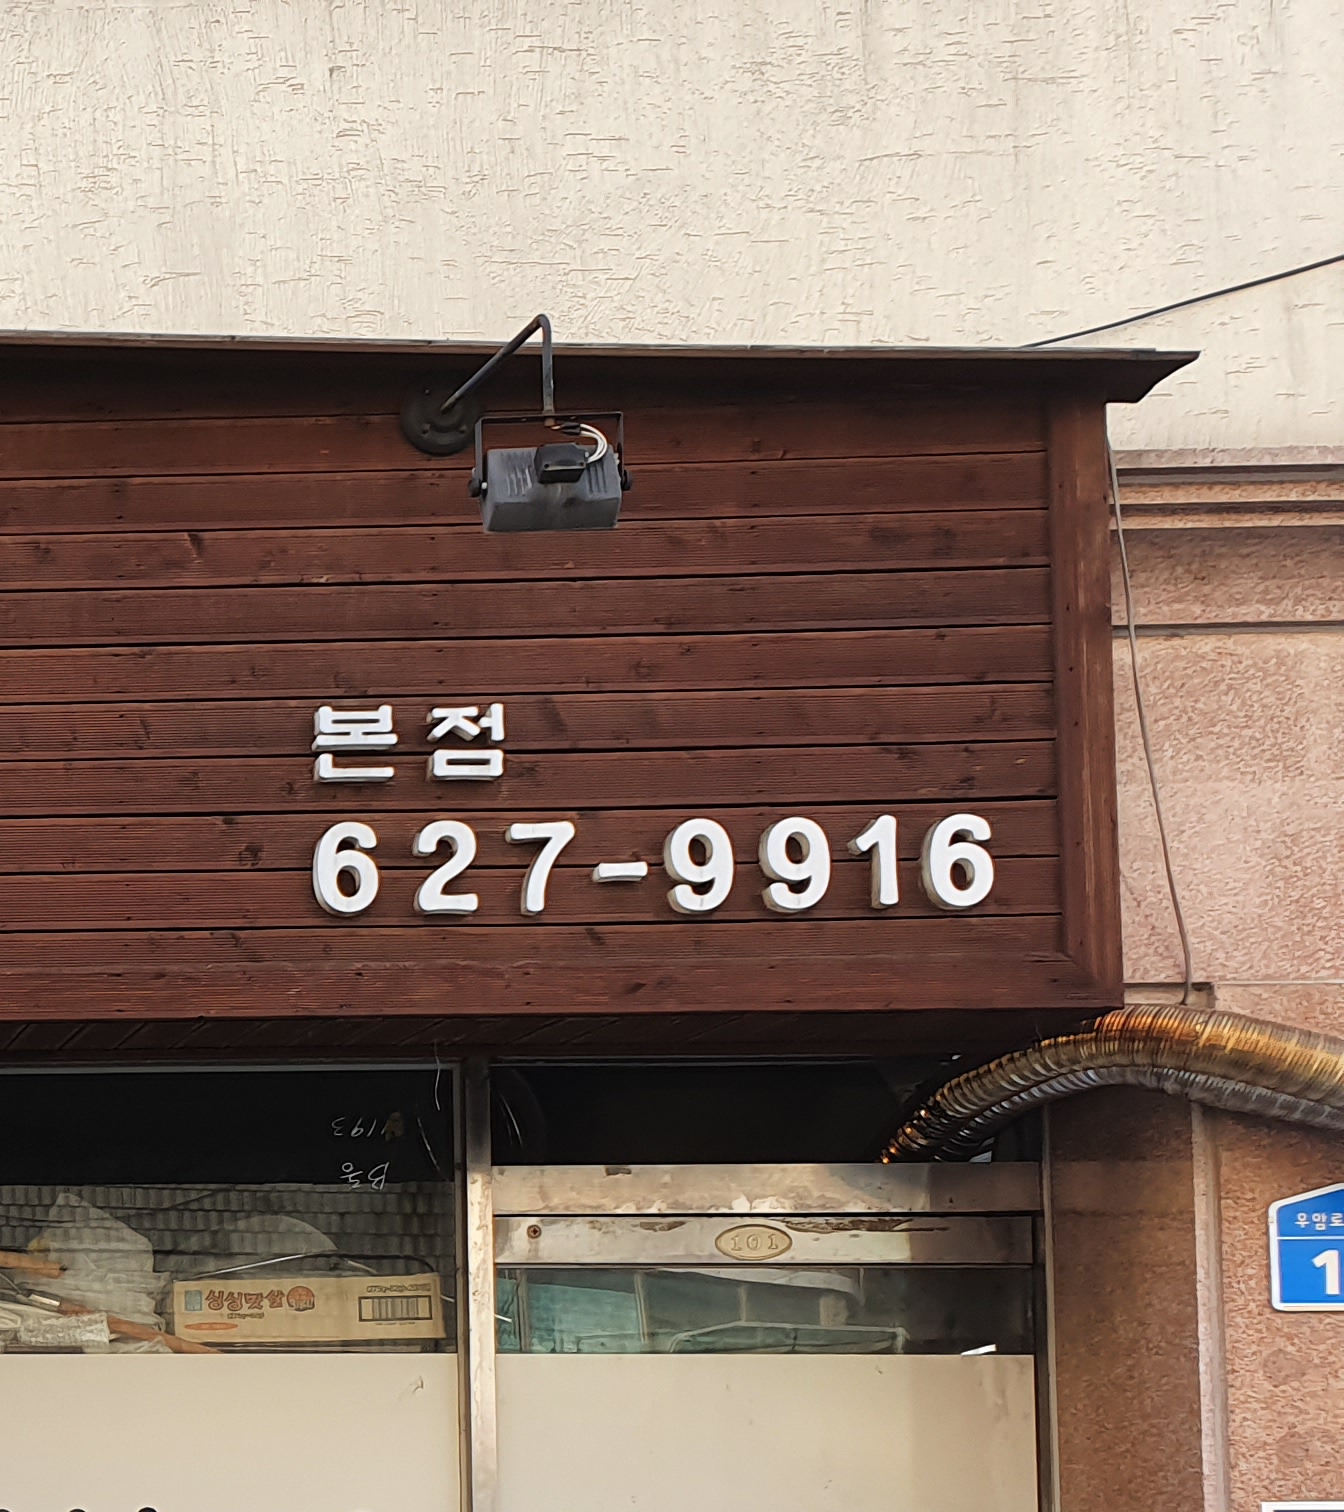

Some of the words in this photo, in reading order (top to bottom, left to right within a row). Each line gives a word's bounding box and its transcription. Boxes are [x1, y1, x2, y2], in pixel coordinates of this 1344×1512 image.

[313, 702, 505, 784] 본점
[312, 812, 996, 917] 627-9916
[731, 1233, 779, 1252] 101
